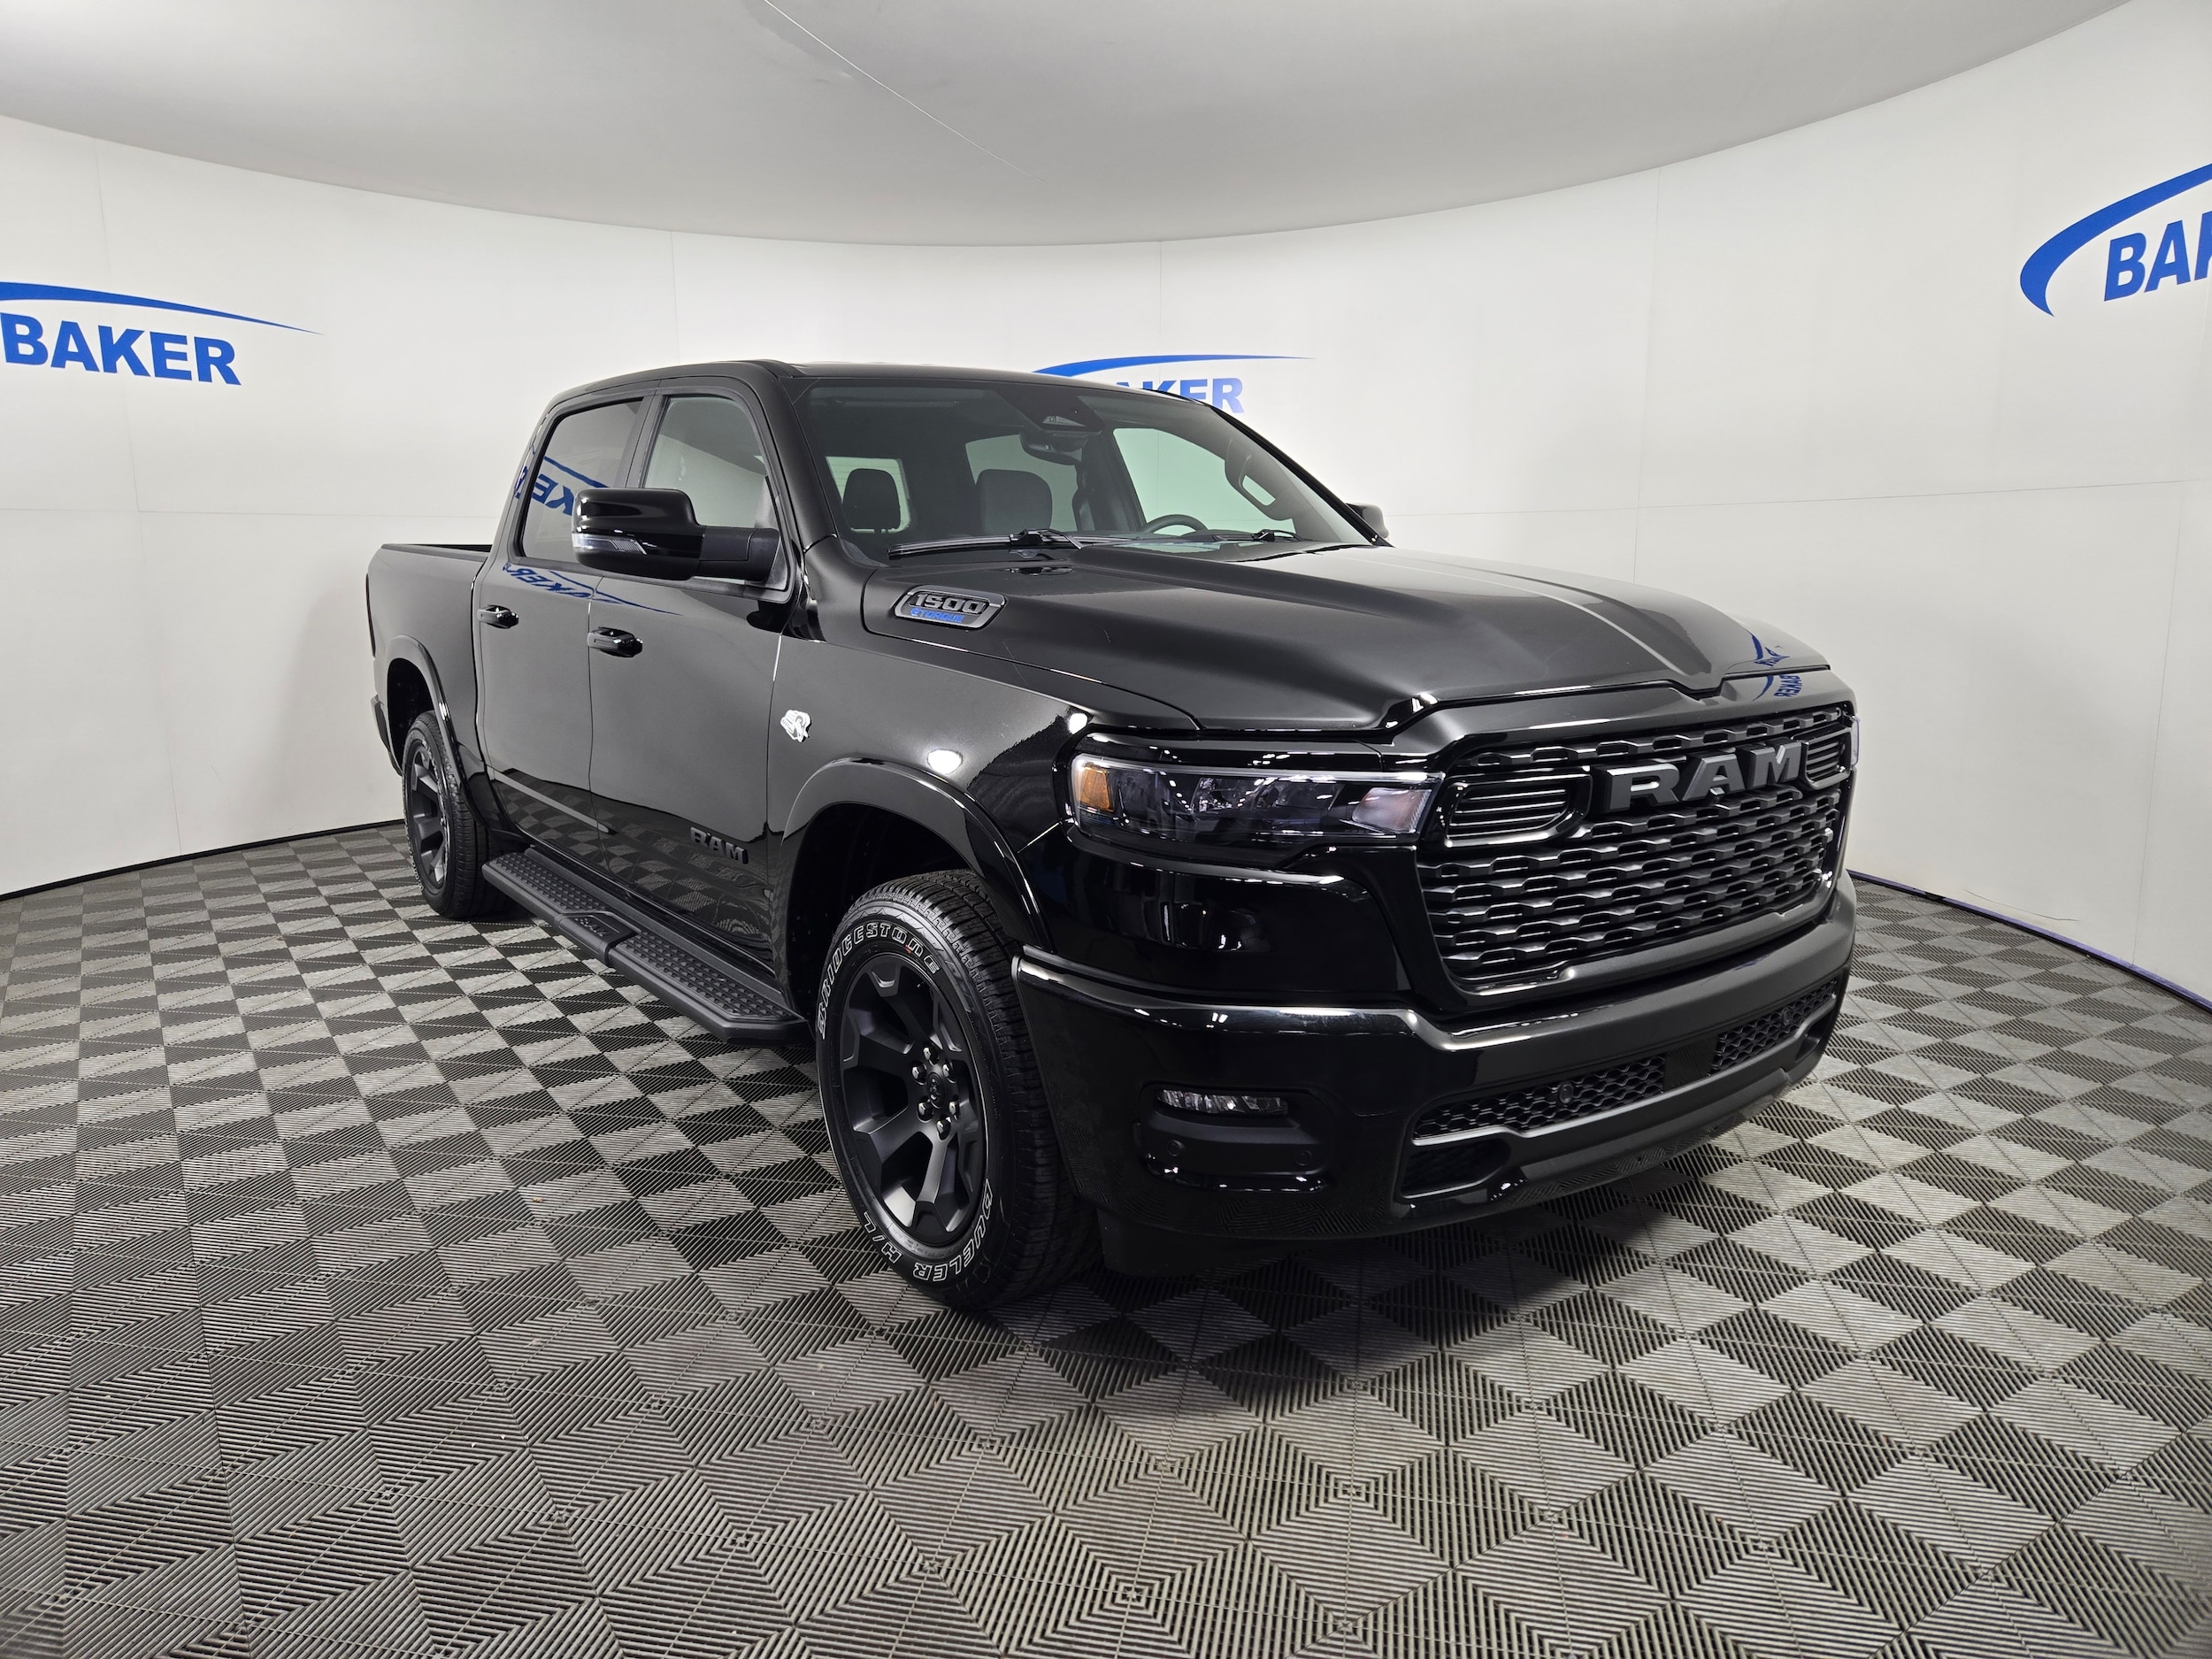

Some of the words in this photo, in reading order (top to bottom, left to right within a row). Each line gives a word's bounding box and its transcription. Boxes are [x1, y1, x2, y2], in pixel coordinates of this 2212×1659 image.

[0, 311, 242, 386] BAKER
[915, 593, 987, 614] 1500
[1603, 737, 1802, 811] RAM
[690, 826, 749, 864] RAM
[817, 922, 941, 1040] BRIDGESTONE
[864, 1210, 903, 1264] H/L
[912, 1178, 994, 1282] DUELER
